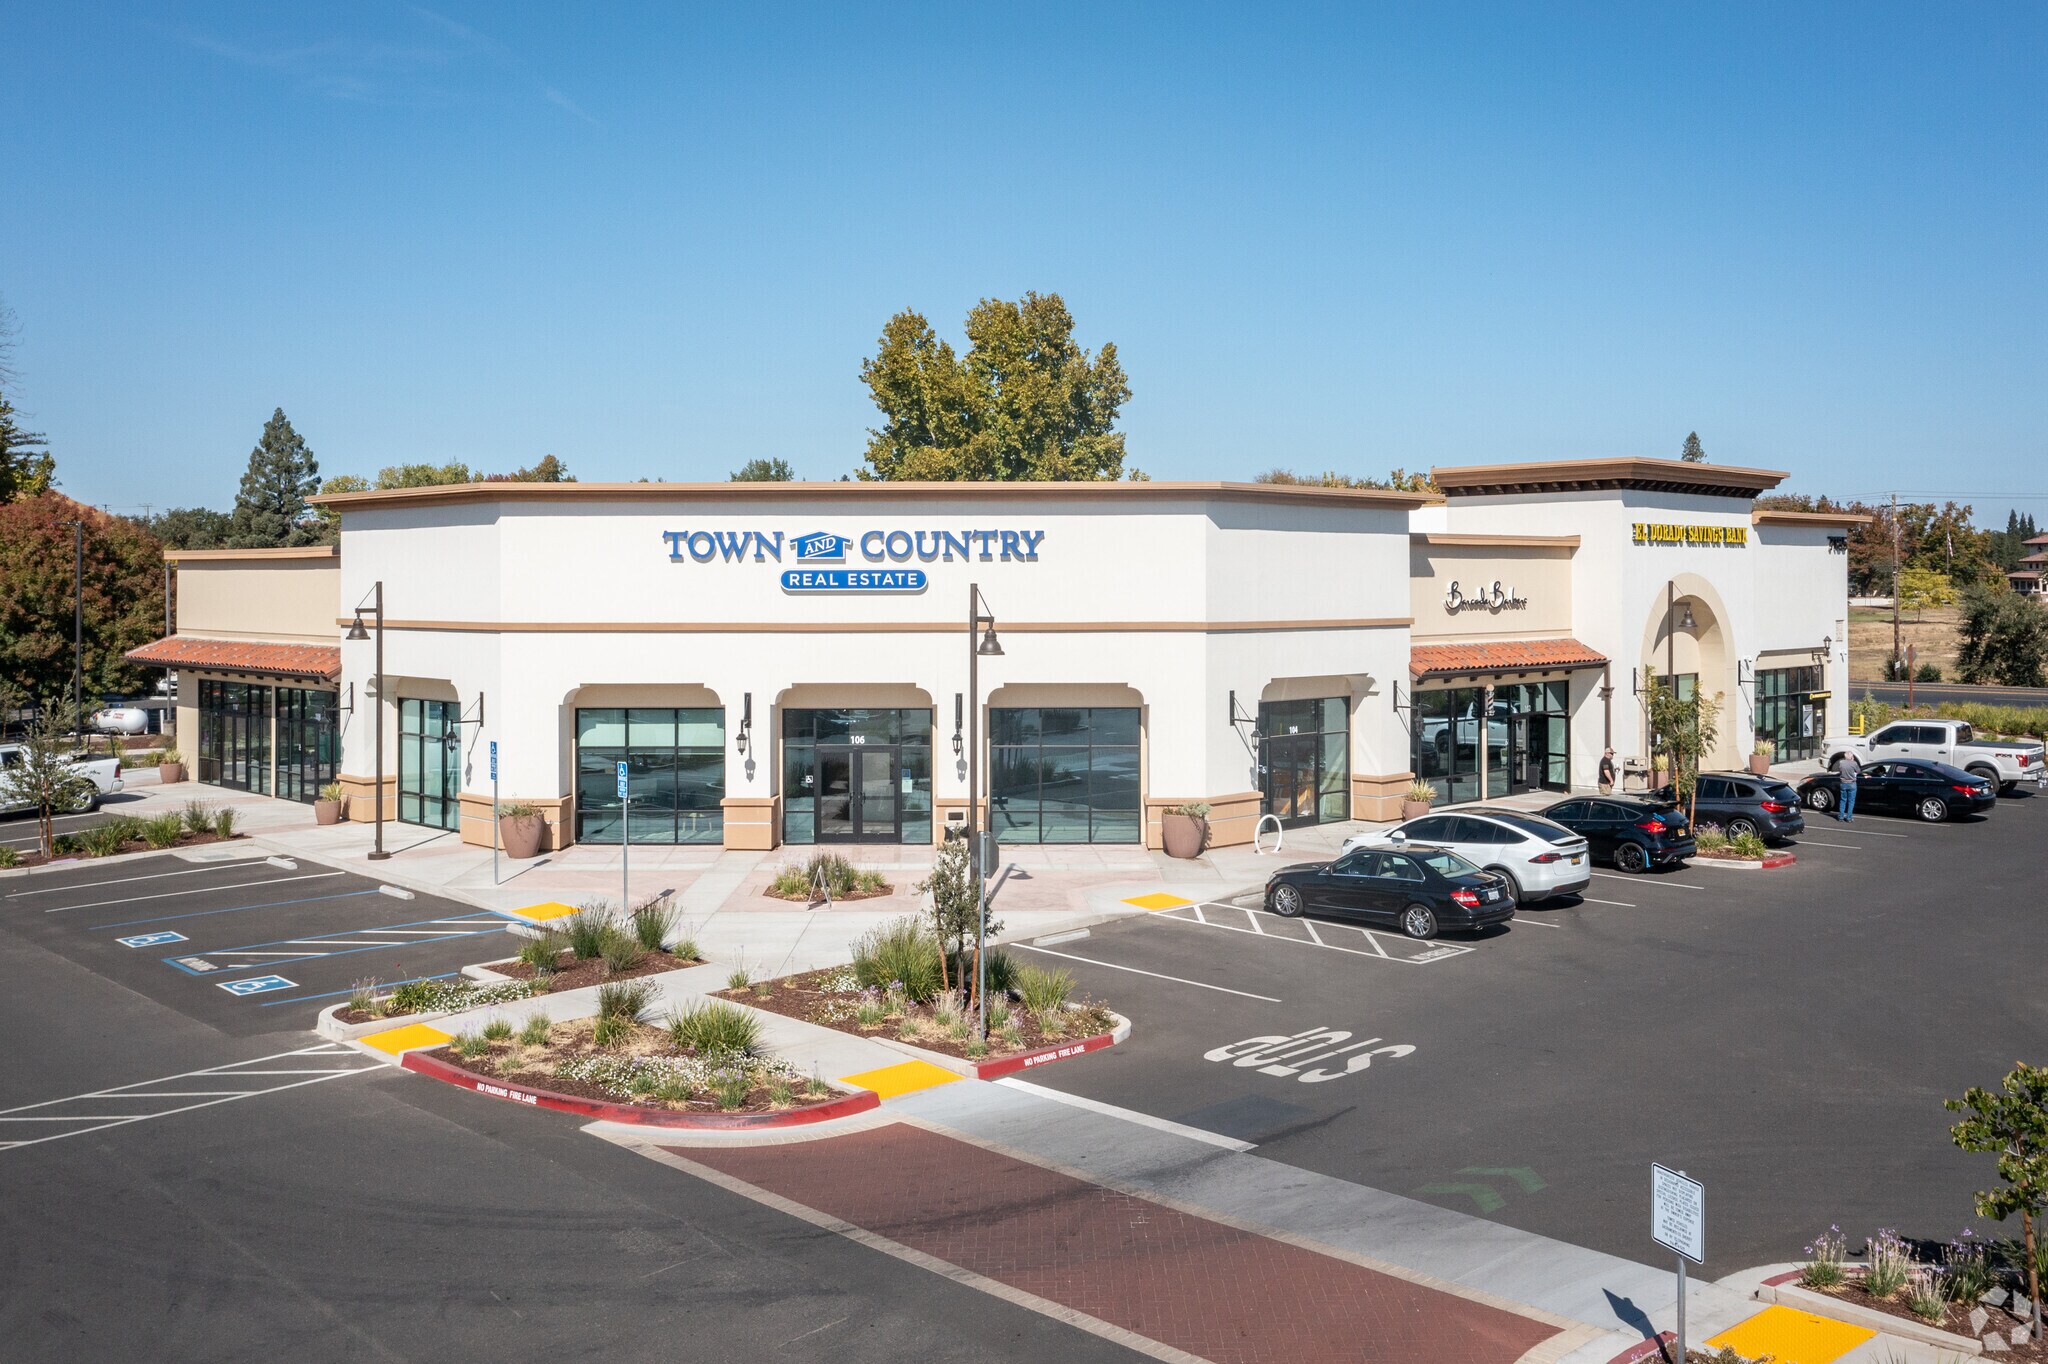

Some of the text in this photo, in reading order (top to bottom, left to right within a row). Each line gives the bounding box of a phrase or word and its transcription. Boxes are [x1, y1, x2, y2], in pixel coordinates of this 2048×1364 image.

[663, 529, 1045, 560] TOWN AND COUNTRY
[1634, 522, 1748, 544] EL DORADO SAVINGS BANK
[789, 573, 918, 586] REAL ESTATE
[850, 735, 866, 745] 106
[1023, 1044, 1086, 1067] NO PARKING FIRE LANE
[1203, 1026, 1417, 1083] STOP
[476, 1082, 538, 1105] NO PARKING FIRE LANE
